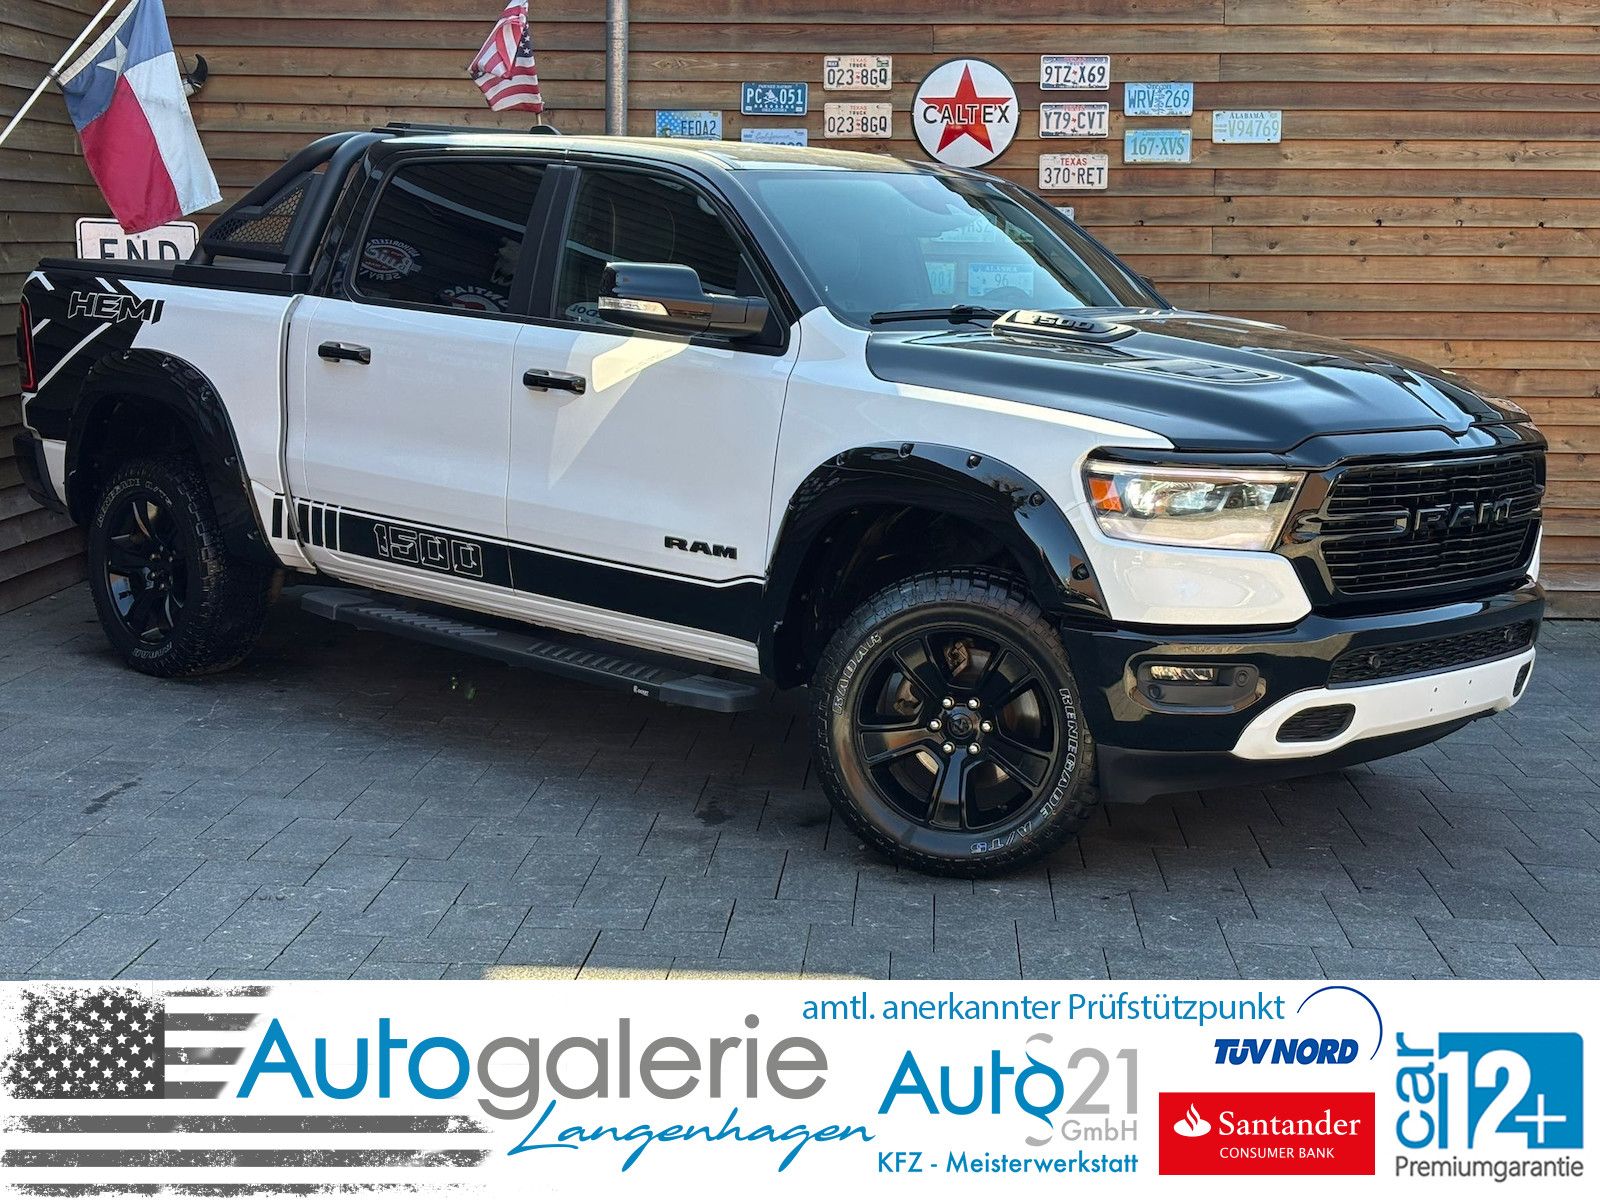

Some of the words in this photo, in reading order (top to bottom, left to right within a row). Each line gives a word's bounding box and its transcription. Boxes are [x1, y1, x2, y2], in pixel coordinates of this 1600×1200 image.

[923, 103, 1011, 125] CALTEX
[1060, 157, 1087, 166] TEXAS
[68, 291, 166, 325] HEMI
[1414, 498, 1513, 532] RAM
[373, 523, 484, 578] 1500
[664, 535, 738, 560] RAM
[1039, 687, 1079, 819] RENEGADE
